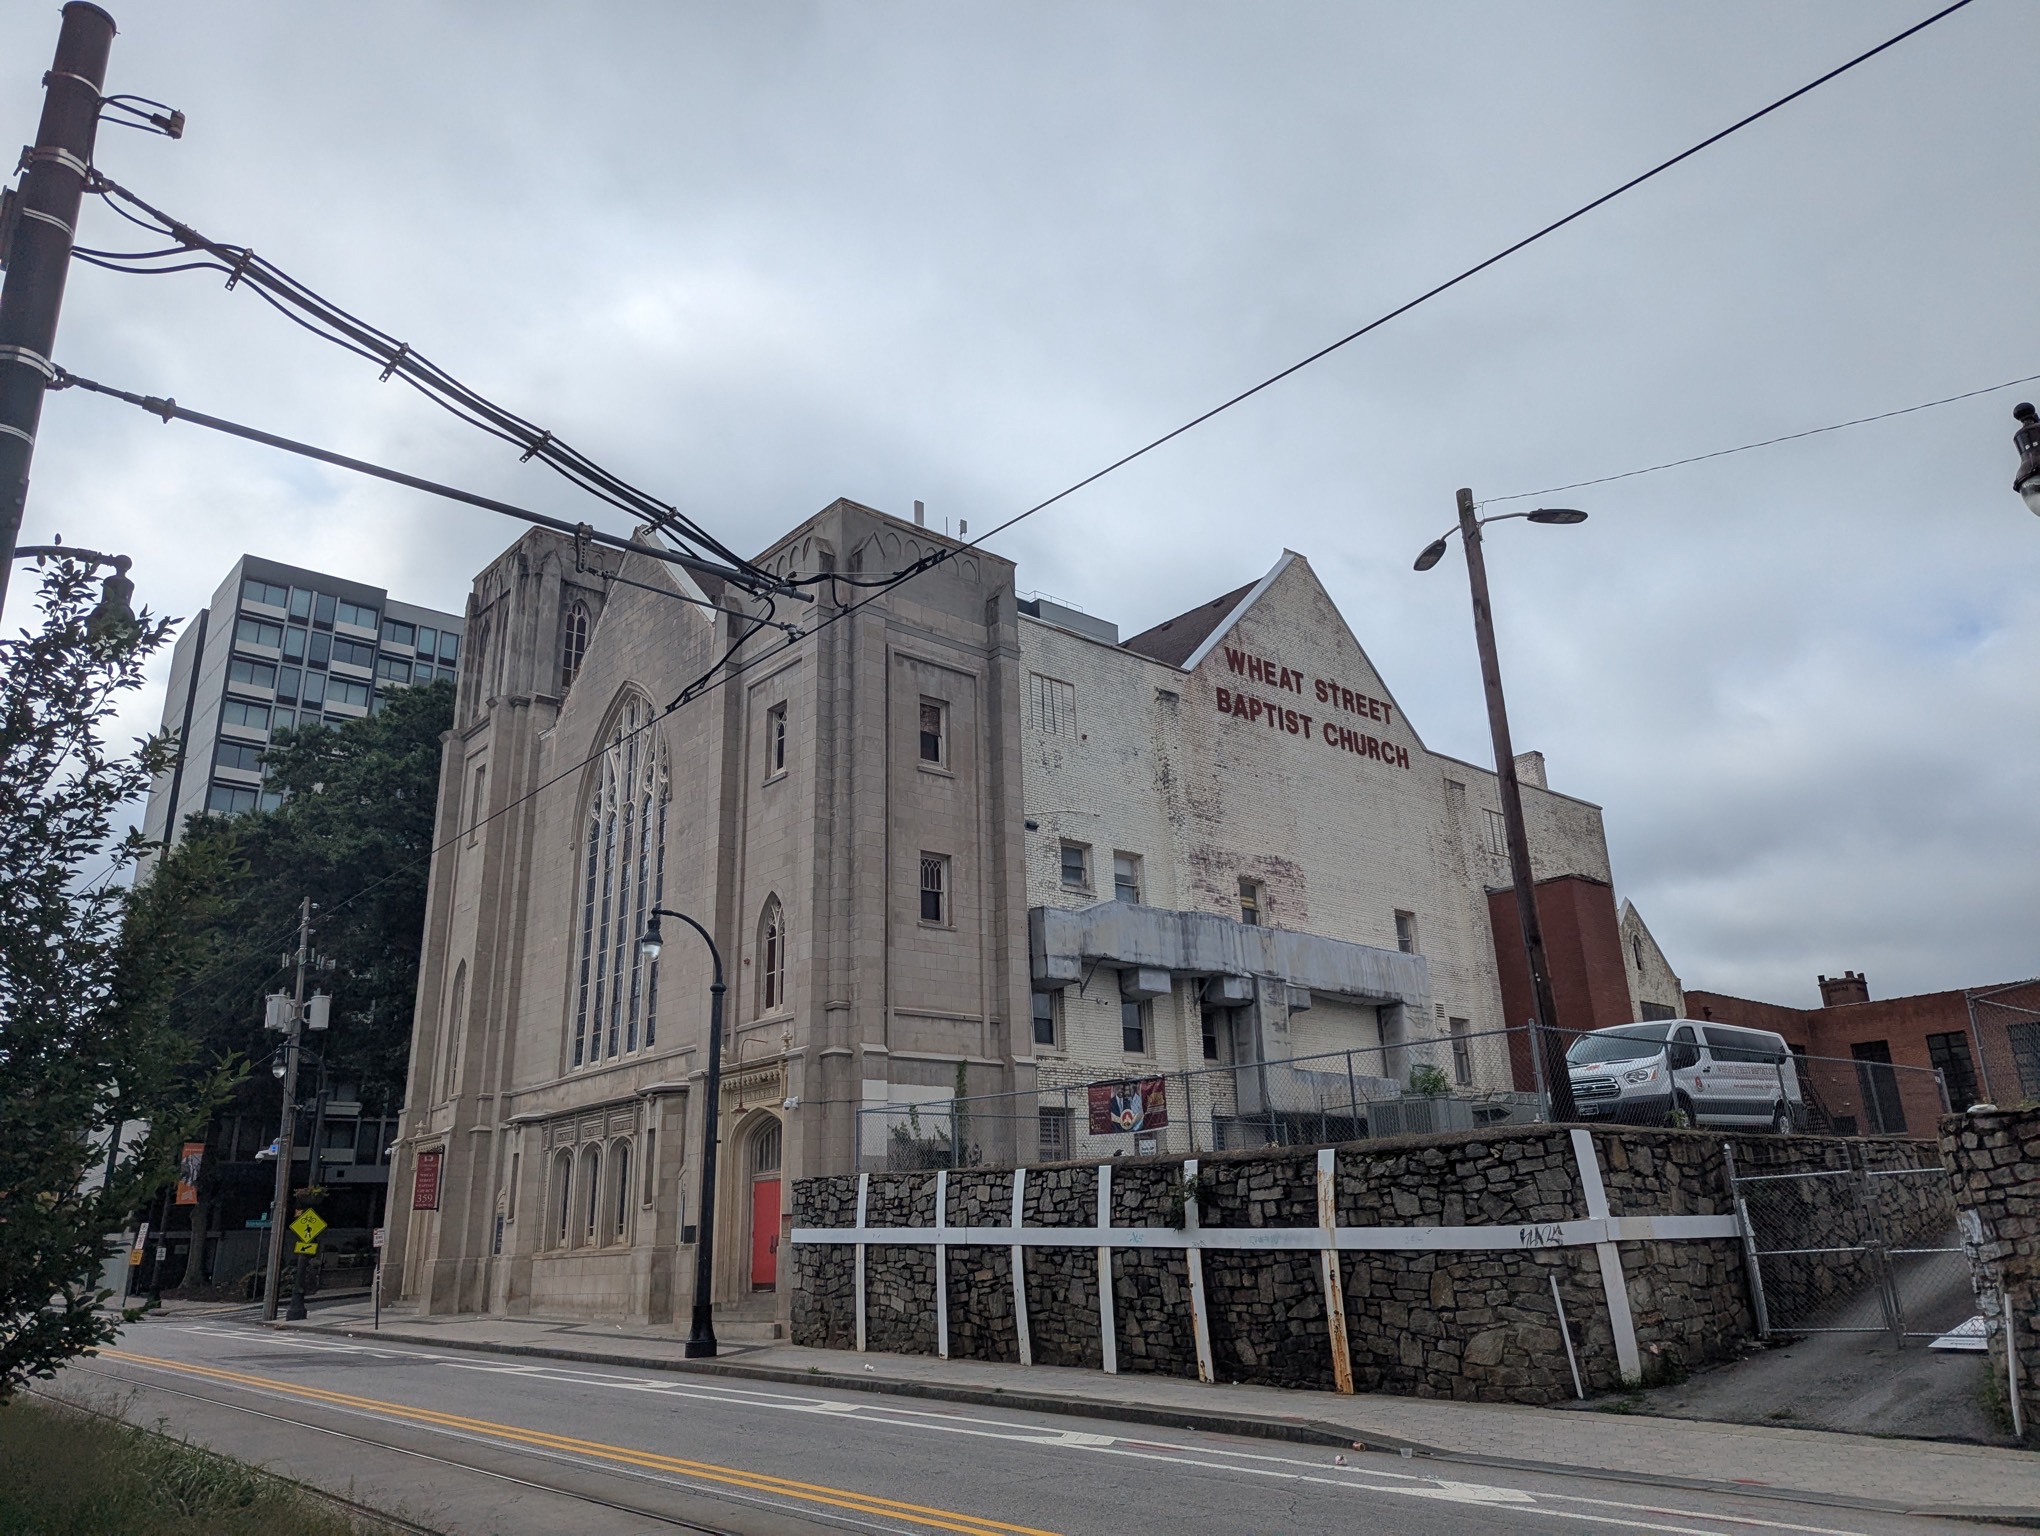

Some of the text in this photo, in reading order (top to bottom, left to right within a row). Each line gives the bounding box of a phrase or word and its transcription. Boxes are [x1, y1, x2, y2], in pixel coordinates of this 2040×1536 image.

[1224, 646, 1392, 725] WHEAT STREET
[1216, 686, 1410, 770] BAPTIST CHURCH
[416, 1194, 433, 1203] 359
